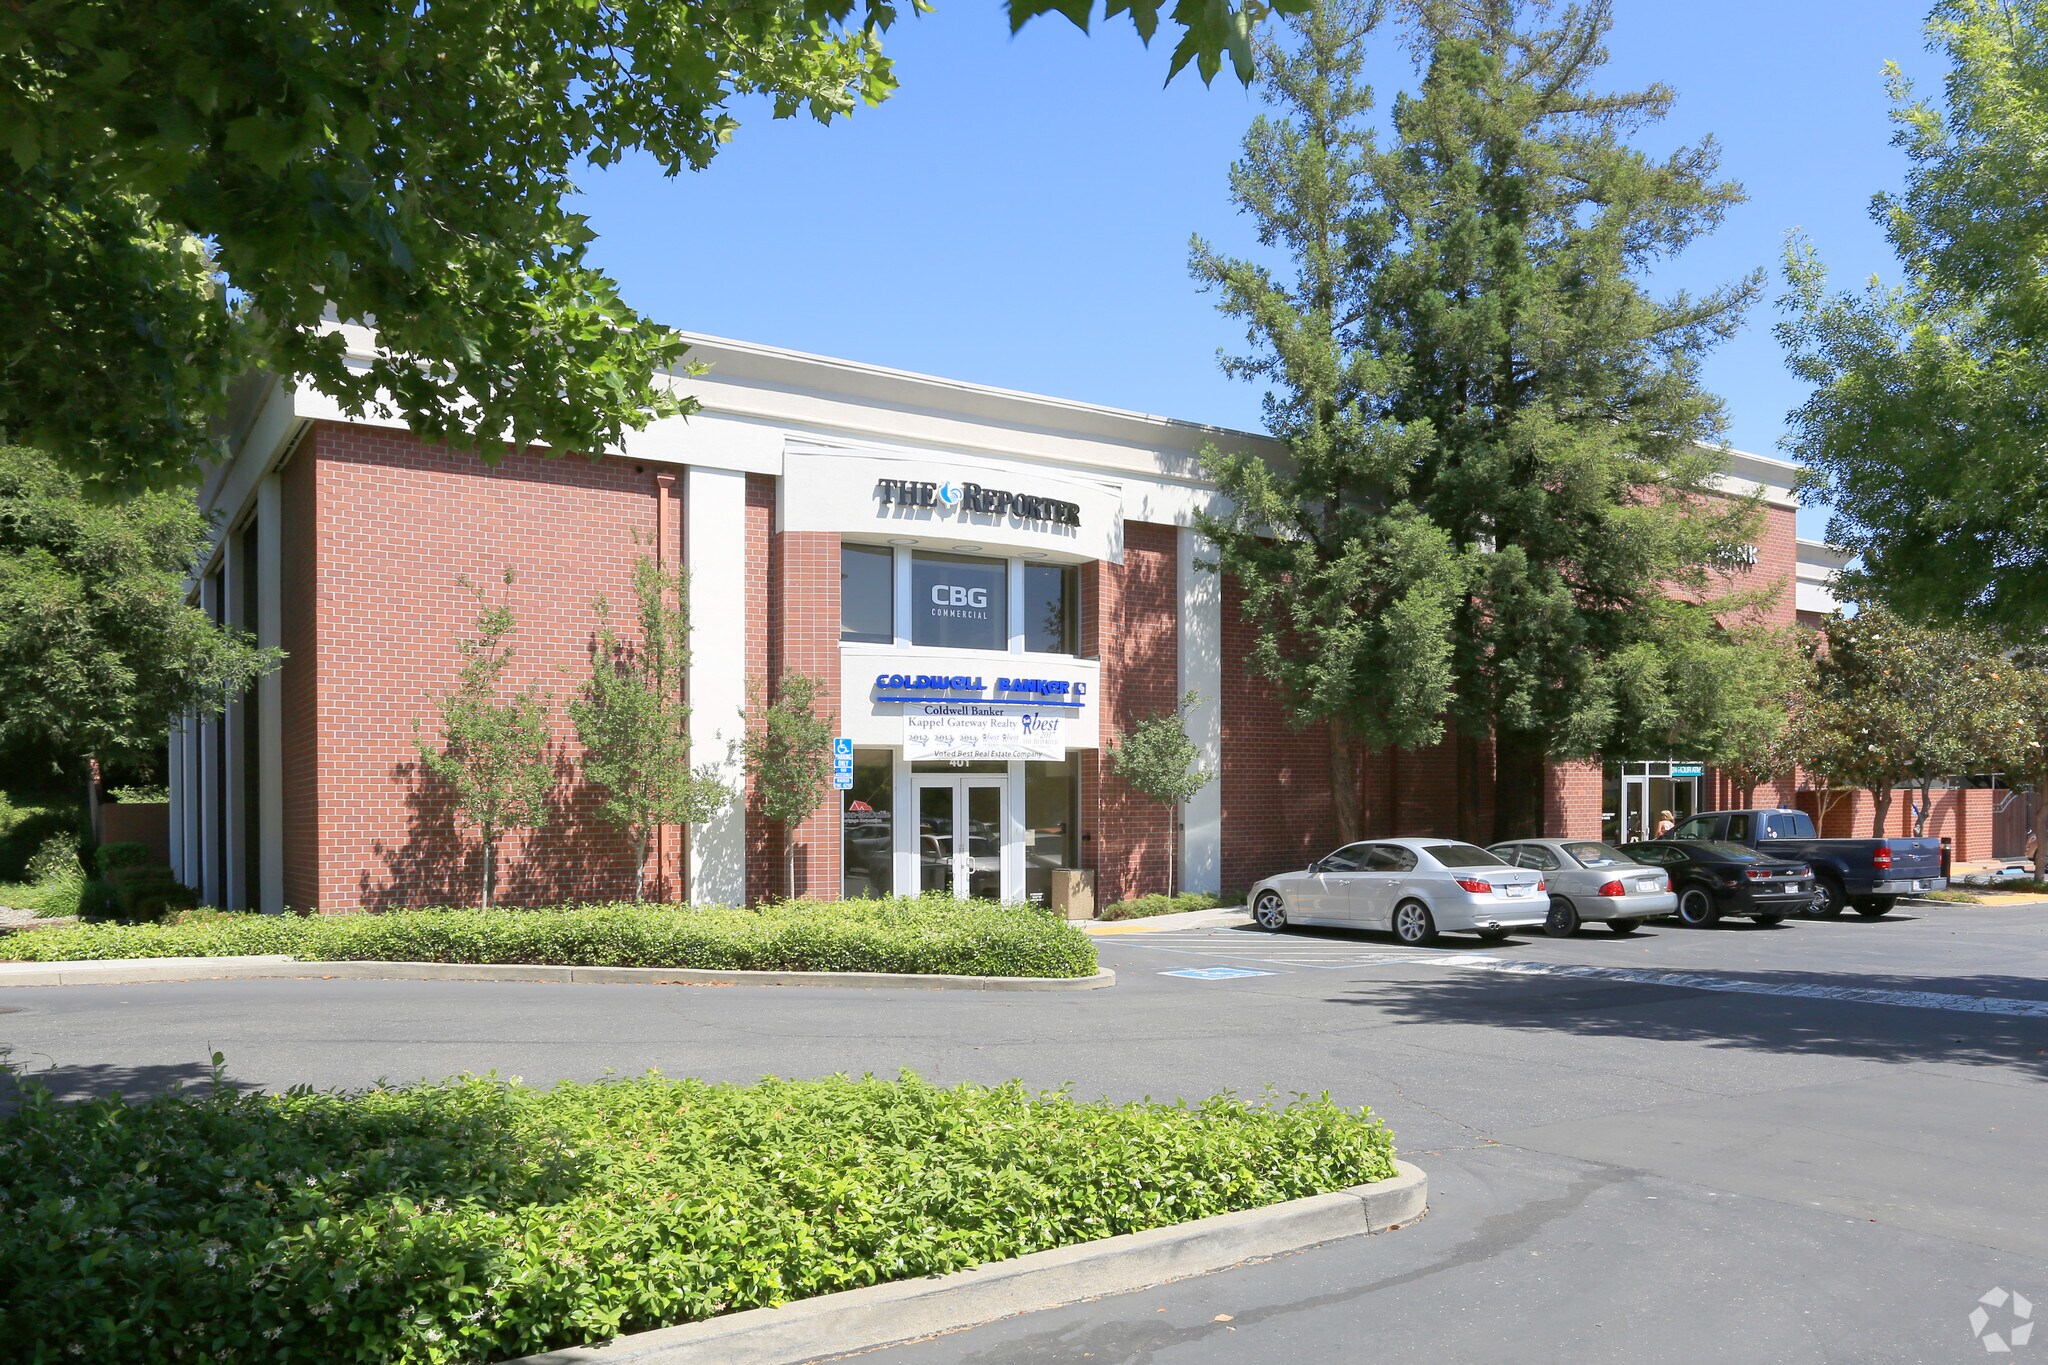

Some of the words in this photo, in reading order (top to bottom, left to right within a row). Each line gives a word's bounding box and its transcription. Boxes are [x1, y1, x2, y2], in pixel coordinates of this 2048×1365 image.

[878, 478, 937, 507] THE
[962, 482, 1081, 527] REPORTER
[931, 585, 987, 608] CBG
[931, 608, 987, 620] COMMERCIAL
[876, 674, 988, 691] COLDWELL
[998, 677, 1070, 696] BANKER
[924, 705, 968, 716] Coldwell
[972, 706, 1004, 716] Banker
[908, 717, 944, 730] Kappel
[947, 717, 989, 730] Gateway
[990, 718, 1018, 730] Realty
[1032, 712, 1059, 732] best
[974, 750, 989, 758] Real
[991, 750, 1012, 758] Estate
[1012, 750, 1043, 759] Company
[949, 760, 970, 768] 401
